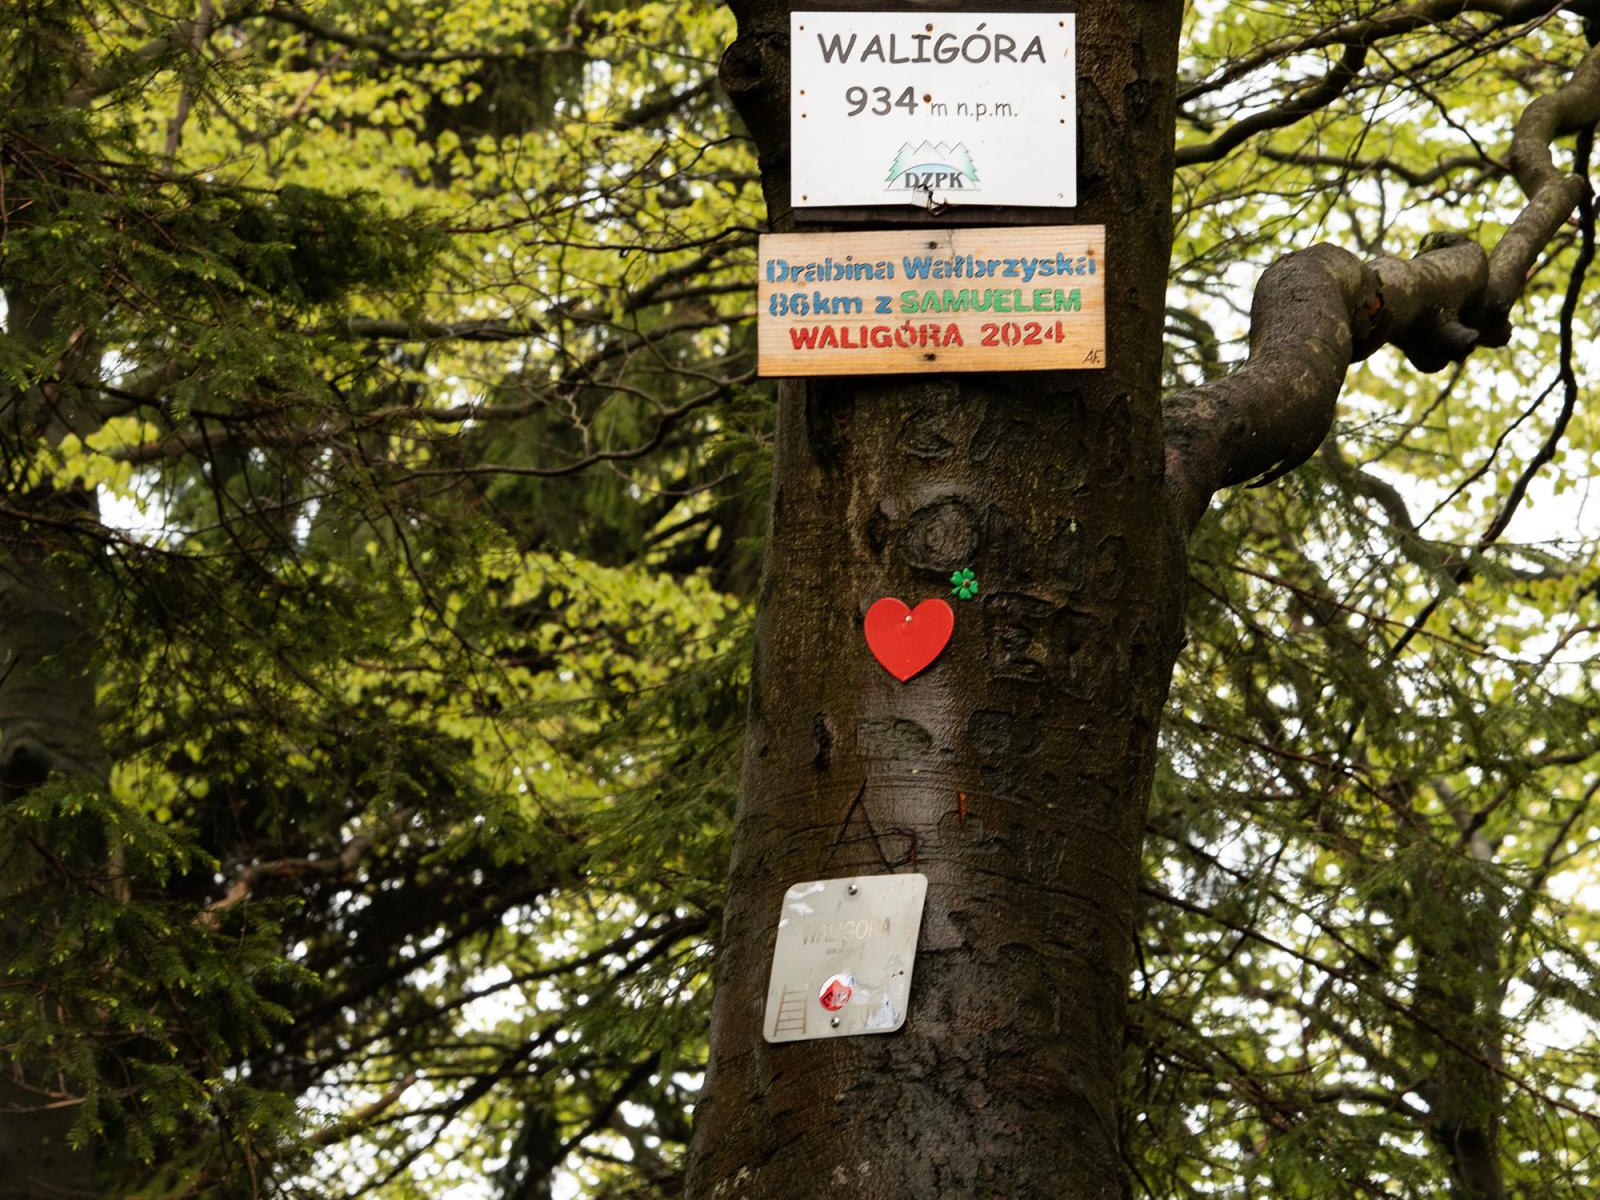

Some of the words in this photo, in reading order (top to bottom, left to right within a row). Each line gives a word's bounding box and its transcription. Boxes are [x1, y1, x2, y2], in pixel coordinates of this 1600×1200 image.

[817, 22, 1046, 63] WALIGÓRA
[845, 86, 918, 117] 934
[930, 101, 948, 116] m
[957, 101, 1018, 121] n.p.m.
[904, 172, 963, 189] DZPK
[766, 256, 894, 283] Drabina
[902, 252, 1096, 283] Wałbrzyska
[769, 291, 862, 316] 86km
[875, 297, 893, 314] z
[900, 288, 1081, 313] SAMUELEM
[789, 320, 963, 350] WALIGÓRA
[980, 320, 1065, 347] 2024
